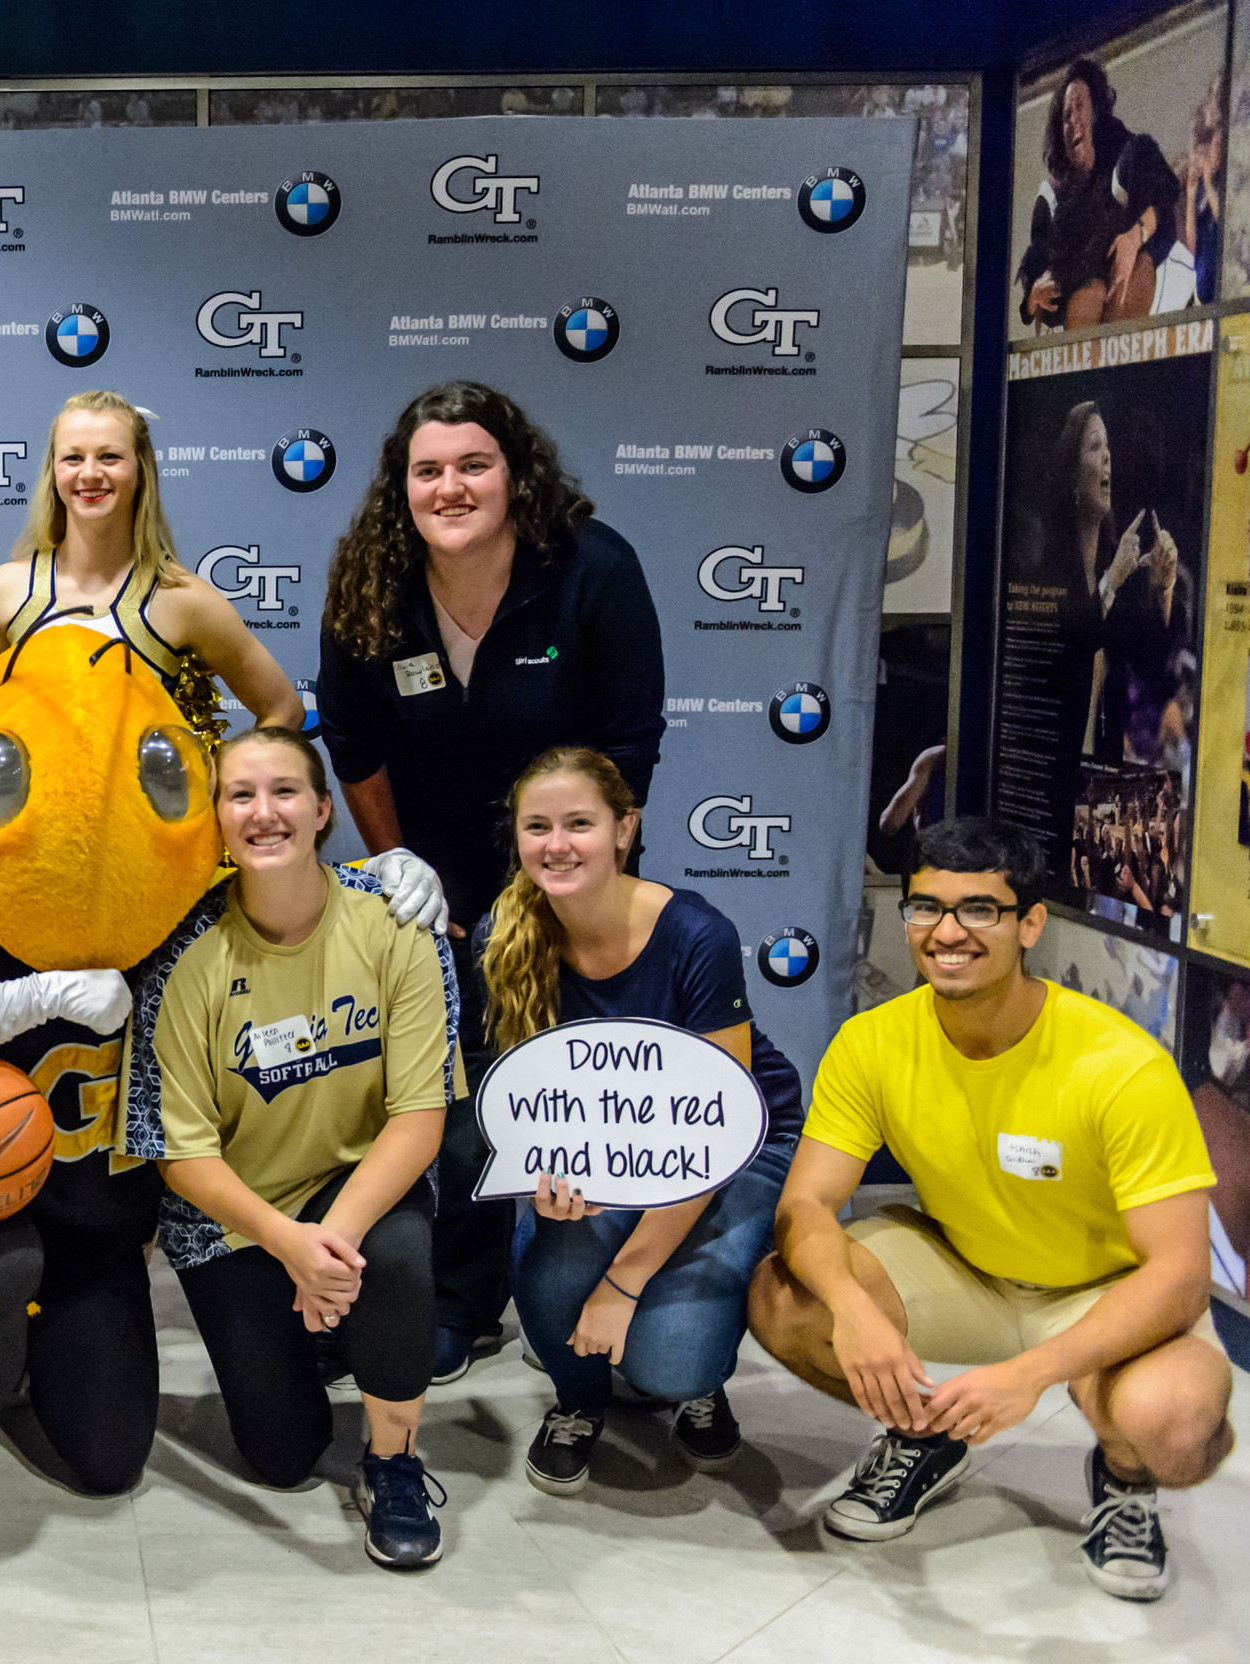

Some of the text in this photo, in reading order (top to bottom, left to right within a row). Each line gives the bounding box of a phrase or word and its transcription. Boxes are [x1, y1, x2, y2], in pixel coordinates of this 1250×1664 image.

[281, 171, 335, 192] BMW
[805, 167, 860, 189] BMW
[111, 188, 268, 205] Atlanta BMW Centers
[430, 154, 540, 224] GT
[628, 183, 791, 201] Atlanta BMW Centers
[110, 209, 190, 222] BMWatl.com
[626, 203, 710, 216] BMWatl.com
[428, 233, 538, 245] RamblinWreck.com
[50, 303, 104, 325] BMW
[560, 297, 614, 319] BMW
[196, 290, 304, 359] GT
[390, 314, 547, 331] Atlanta BMW Centers
[709, 287, 820, 357] GT
[389, 335, 469, 347] BMWatl.com
[1009, 319, 1214, 380] MaCHELLE JOSEPH ERA
[195, 367, 303, 378] RamblinWreck.com
[705, 365, 816, 377] RamblinWreck.com
[277, 429, 330, 451] BMW
[788, 429, 842, 451] BMW
[168, 446, 206, 461] BMW
[209, 446, 266, 461] Centers
[616, 444, 774, 461] Atlanta BMW Centers
[615, 464, 695, 476] BMWatl.com
[196, 545, 301, 611] GT
[697, 545, 804, 612] GT
[694, 620, 801, 631] RamblinWreck.com
[776, 683, 826, 702] BMW
[667, 698, 763, 713] BMW Centers
[688, 795, 791, 860] GT
[685, 868, 789, 878] RamblinWreck.com
[764, 928, 814, 947] BMW
[332, 995, 380, 1036] Tec
[566, 1039, 663, 1071] Down
[259, 1053, 338, 1085] SOFTBALL
[508, 1088, 725, 1127] with the red
[524, 1141, 710, 1180] and black!
